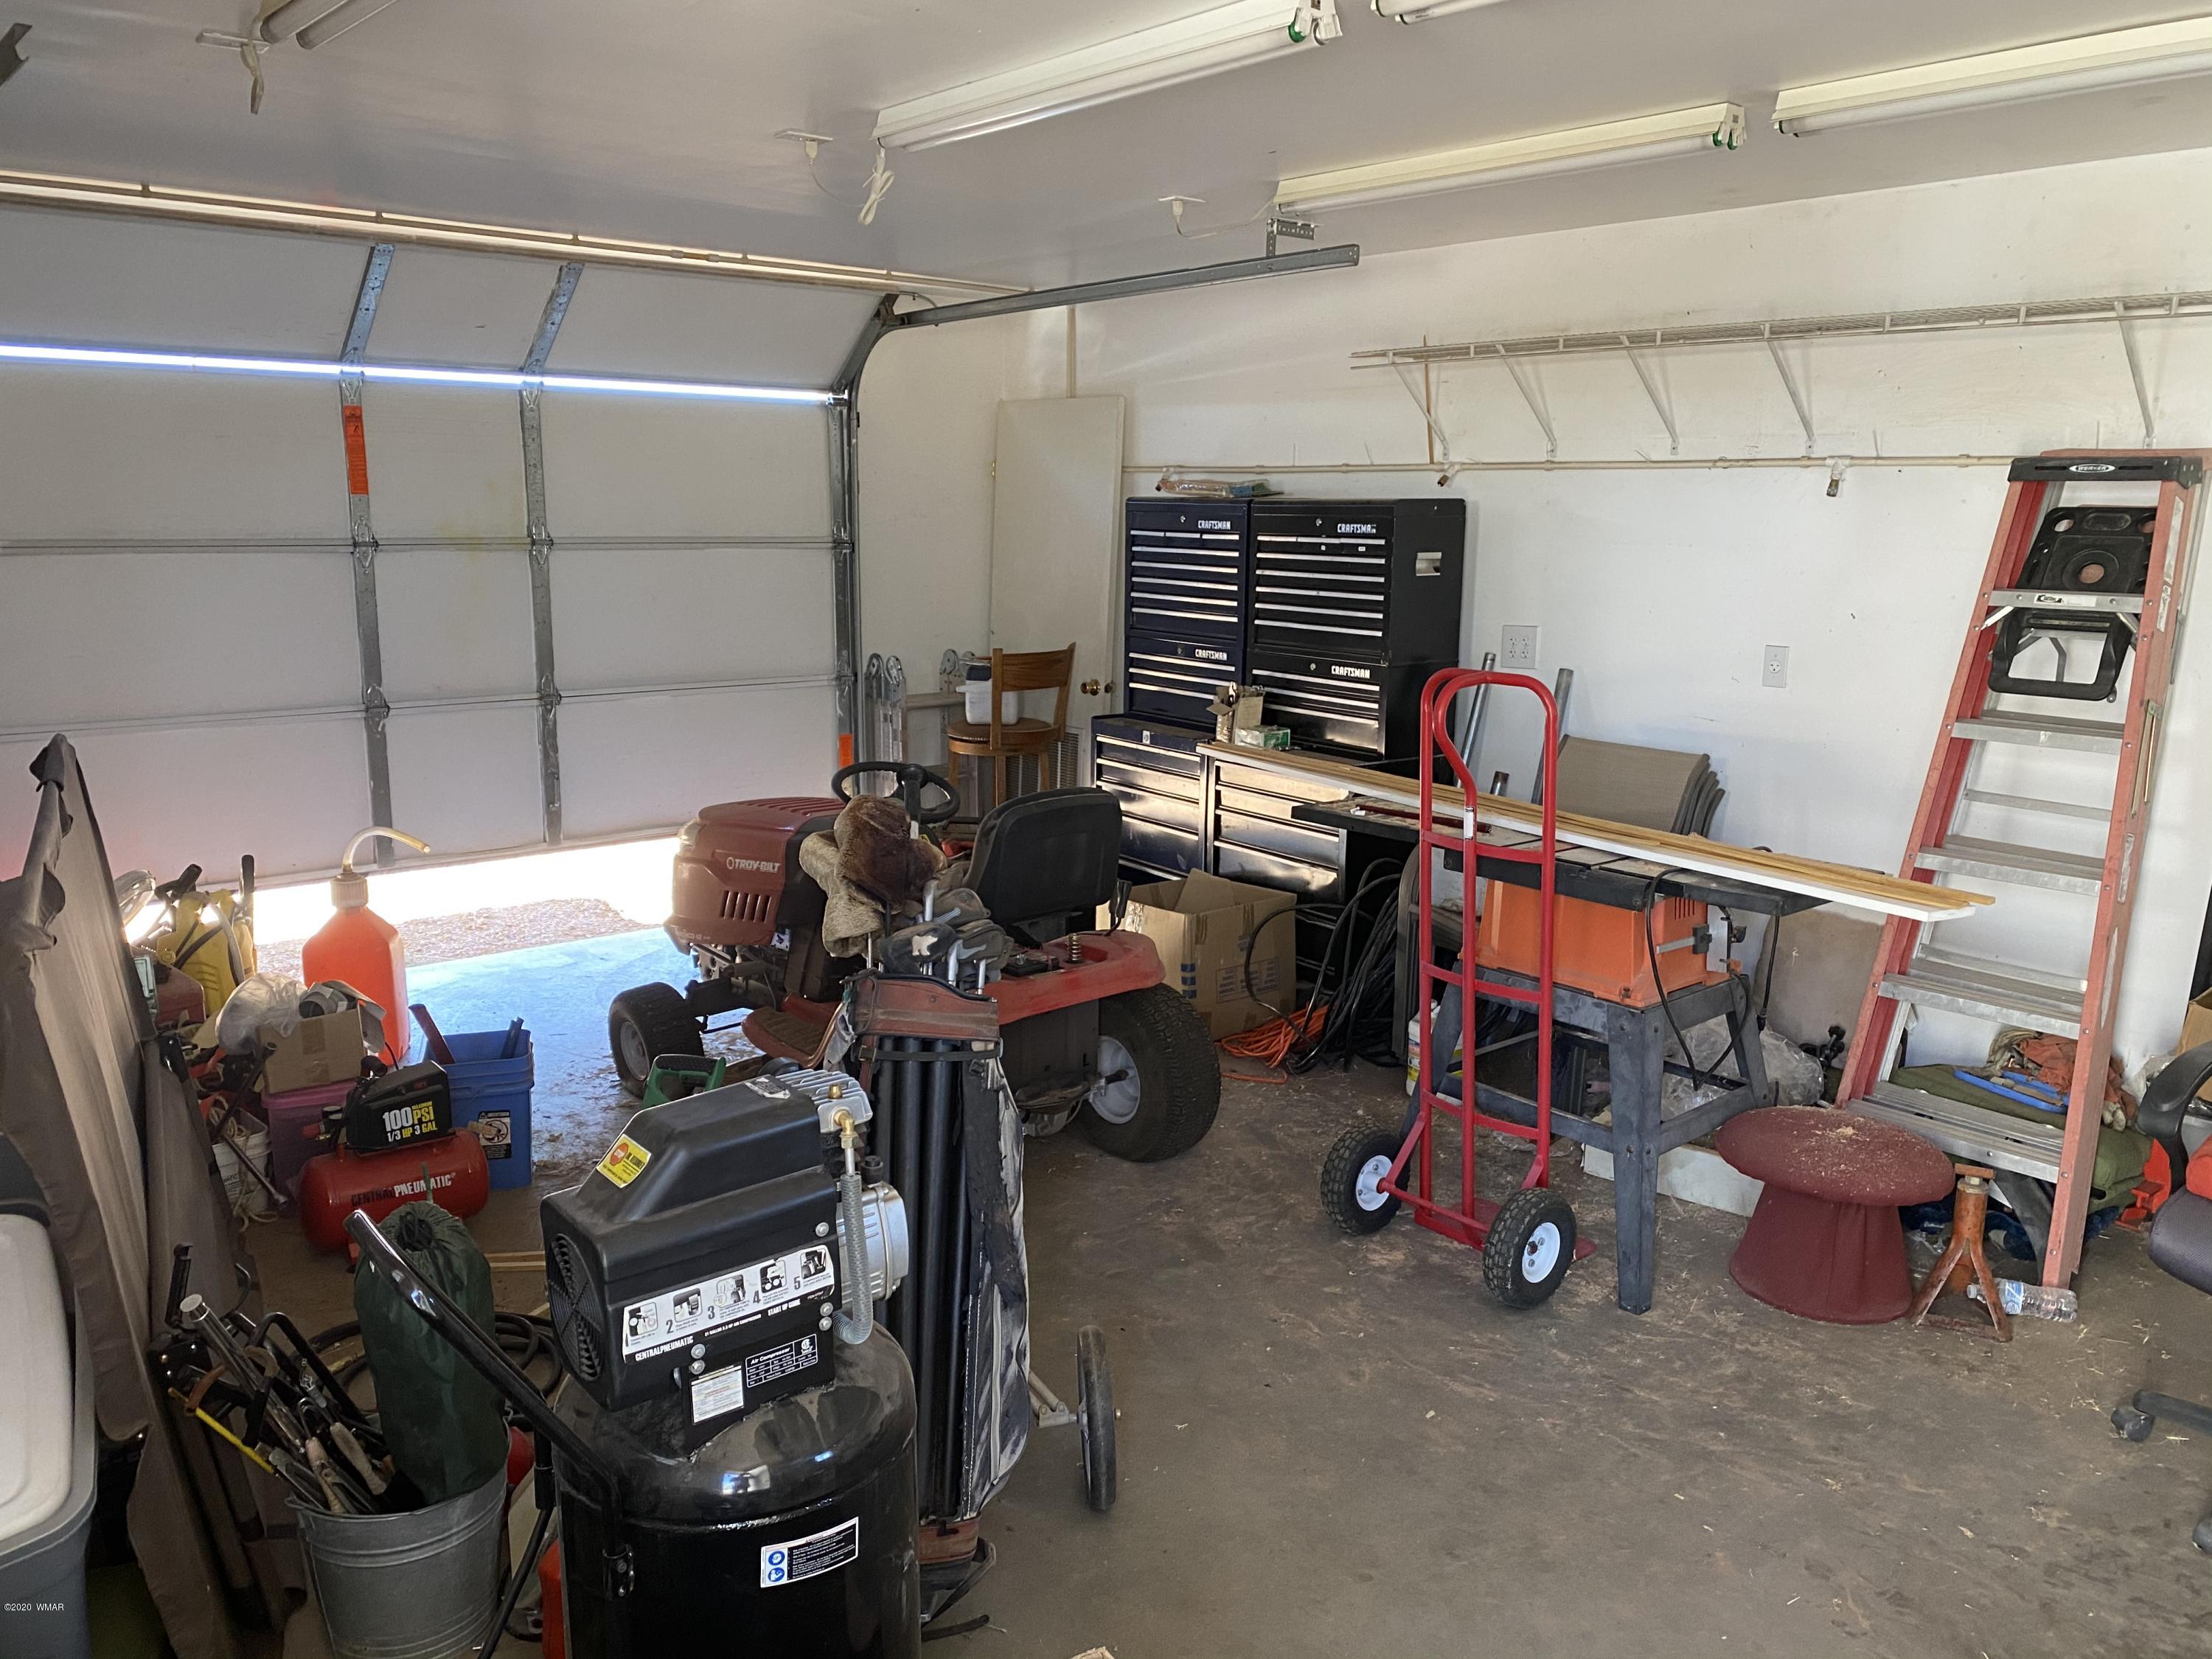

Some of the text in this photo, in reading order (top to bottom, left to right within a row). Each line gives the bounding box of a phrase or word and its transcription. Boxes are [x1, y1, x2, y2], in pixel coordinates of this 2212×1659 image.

[1197, 520, 1231, 530] CRAFTSMAN
[1194, 649, 1228, 661] CRAFTSMAN
[1331, 665, 1371, 679] CRAFTSMAN
[734, 858, 781, 872] TROY-BILT
[382, 1106, 434, 1132] 100 PSI
[387, 1130, 401, 1142] 1/3
[402, 1127, 413, 1138] HP
[414, 1124, 421, 1135] 3
[793, 1276, 801, 1290] 5
[752, 1290, 762, 1304] 4
[707, 1305, 715, 1320] 3
[768, 1304, 782, 1316] START
[666, 1319, 674, 1335] 2
[759, 1347, 790, 1361] Compressor
